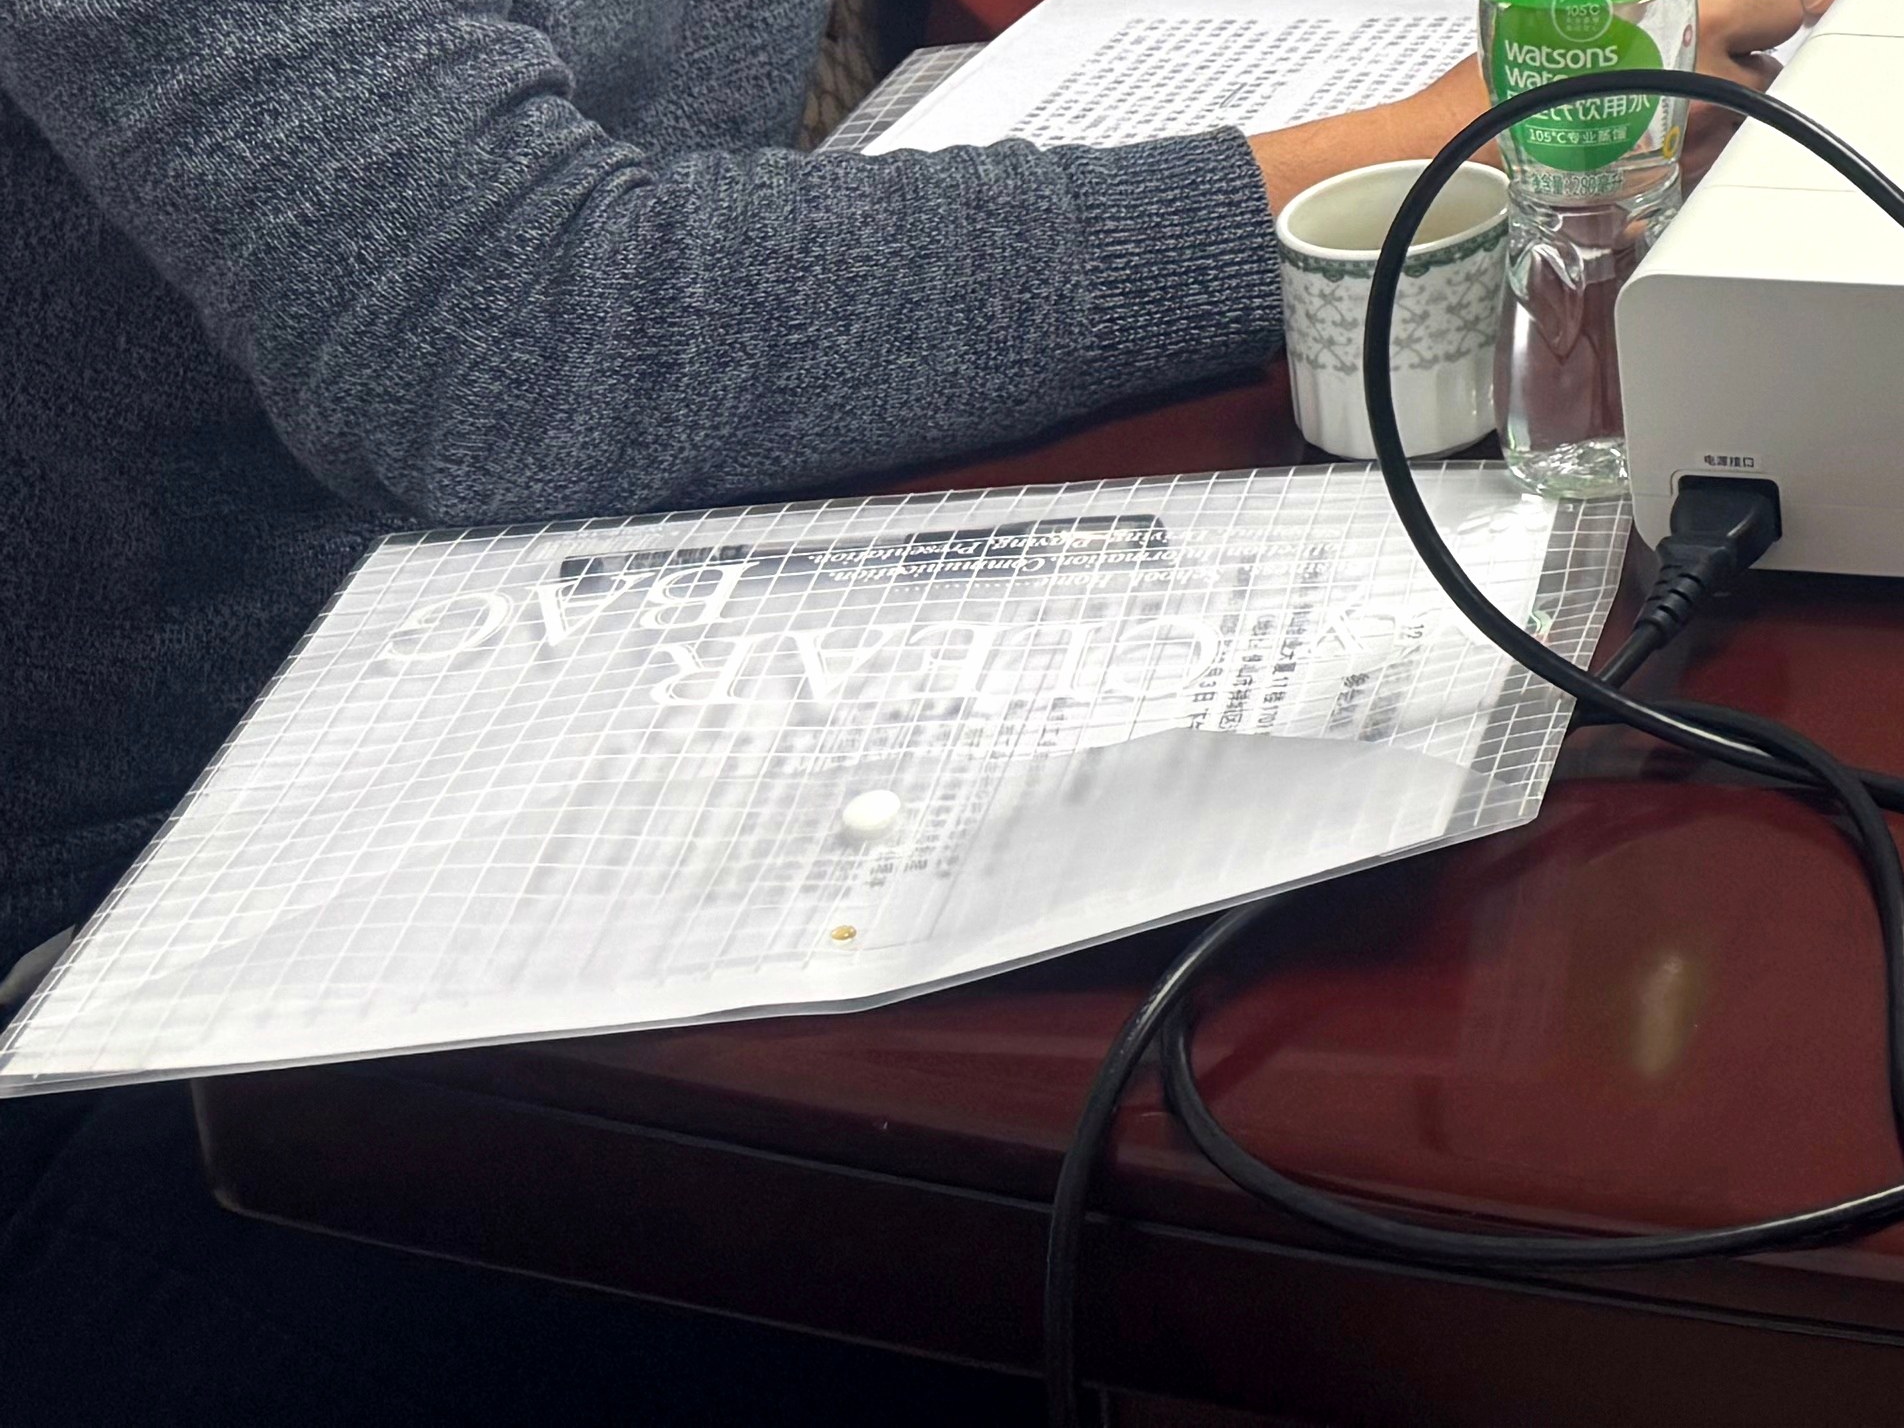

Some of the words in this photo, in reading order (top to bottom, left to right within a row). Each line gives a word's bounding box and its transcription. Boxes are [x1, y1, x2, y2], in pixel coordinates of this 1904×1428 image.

[1505, 64, 1569, 88] Wate
[1703, 454, 1755, 468] 电源接口
